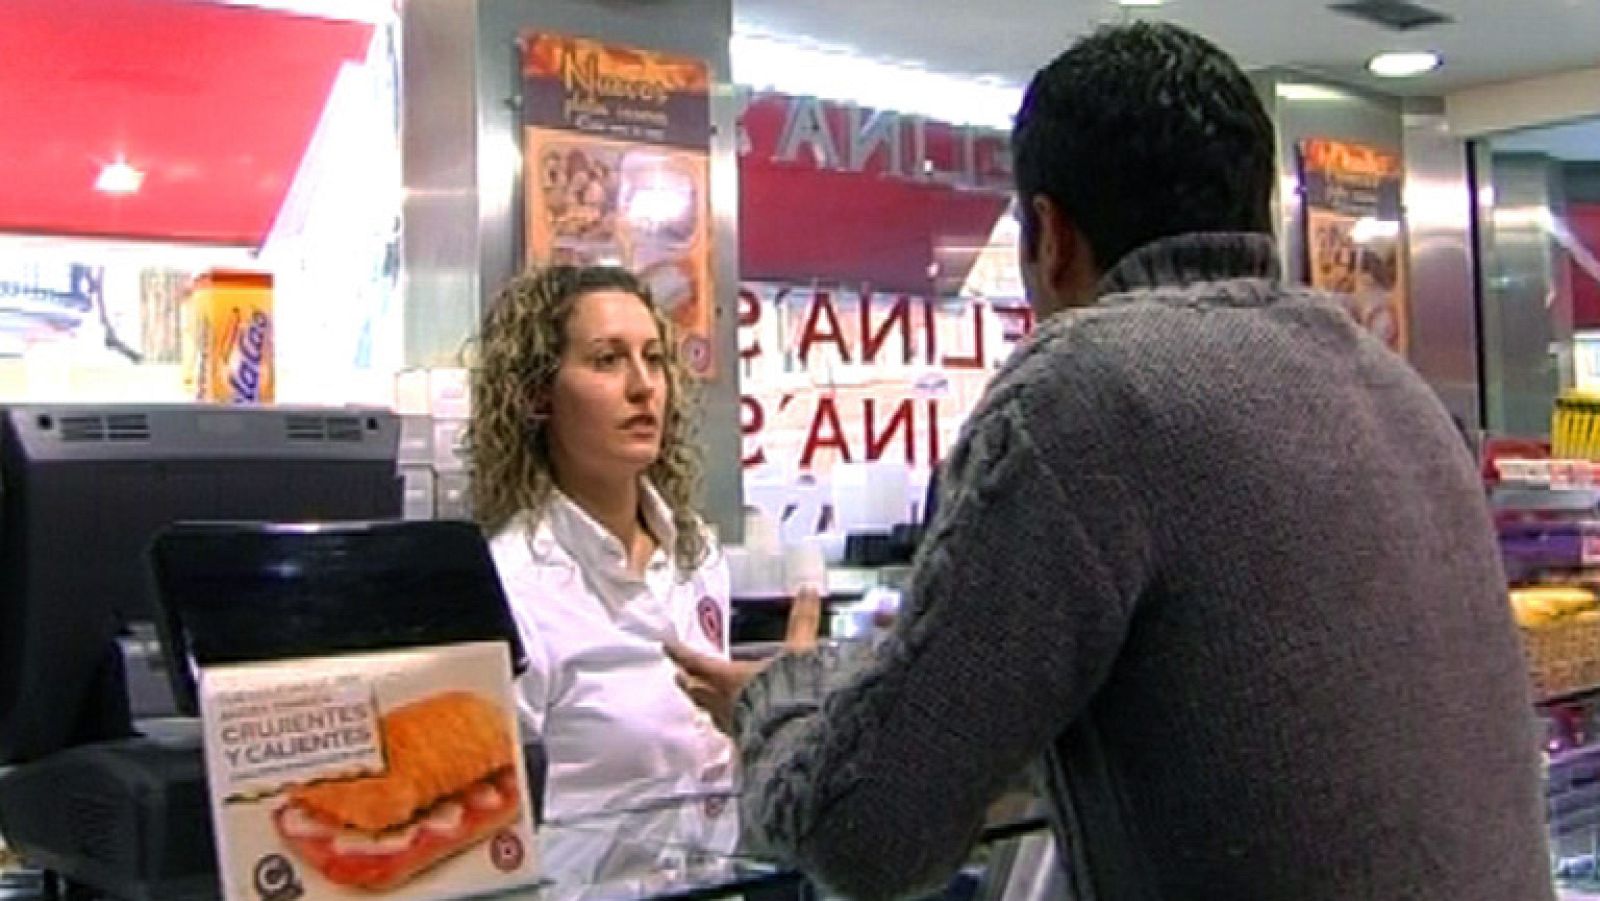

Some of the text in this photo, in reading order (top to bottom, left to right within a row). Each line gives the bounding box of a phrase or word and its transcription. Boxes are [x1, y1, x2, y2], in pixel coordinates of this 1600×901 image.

[228, 309, 268, 404] laCao
[221, 702, 370, 745] CRUJIENTES
[224, 749, 241, 767] Y
[245, 728, 372, 765] CALIENTES
